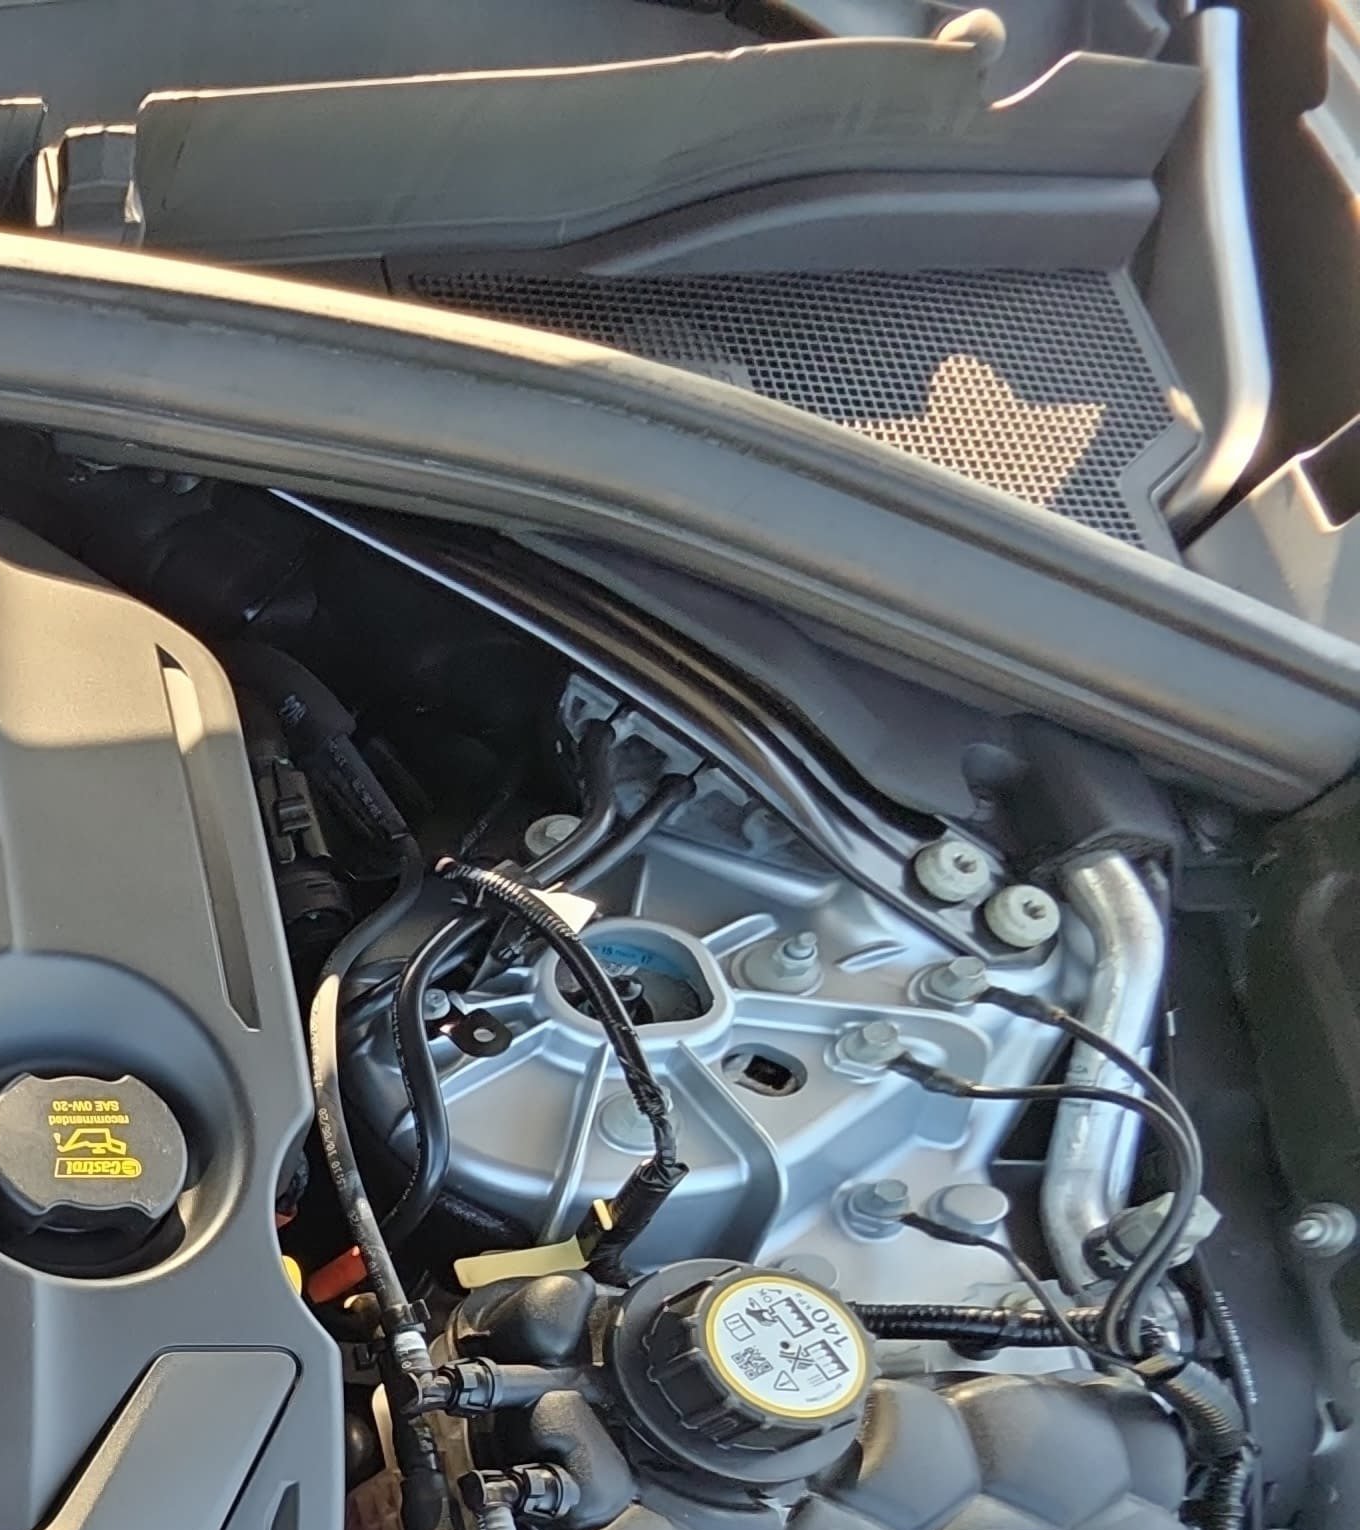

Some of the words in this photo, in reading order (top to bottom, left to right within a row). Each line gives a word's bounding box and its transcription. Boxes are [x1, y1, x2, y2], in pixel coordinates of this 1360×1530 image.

[52, 1100, 93, 1112] 0W-20
[94, 1100, 120, 1112] SAE
[48, 1114, 130, 1127] recommended
[66, 1159, 122, 1176] Castrol
[810, 1306, 849, 1348] 140
